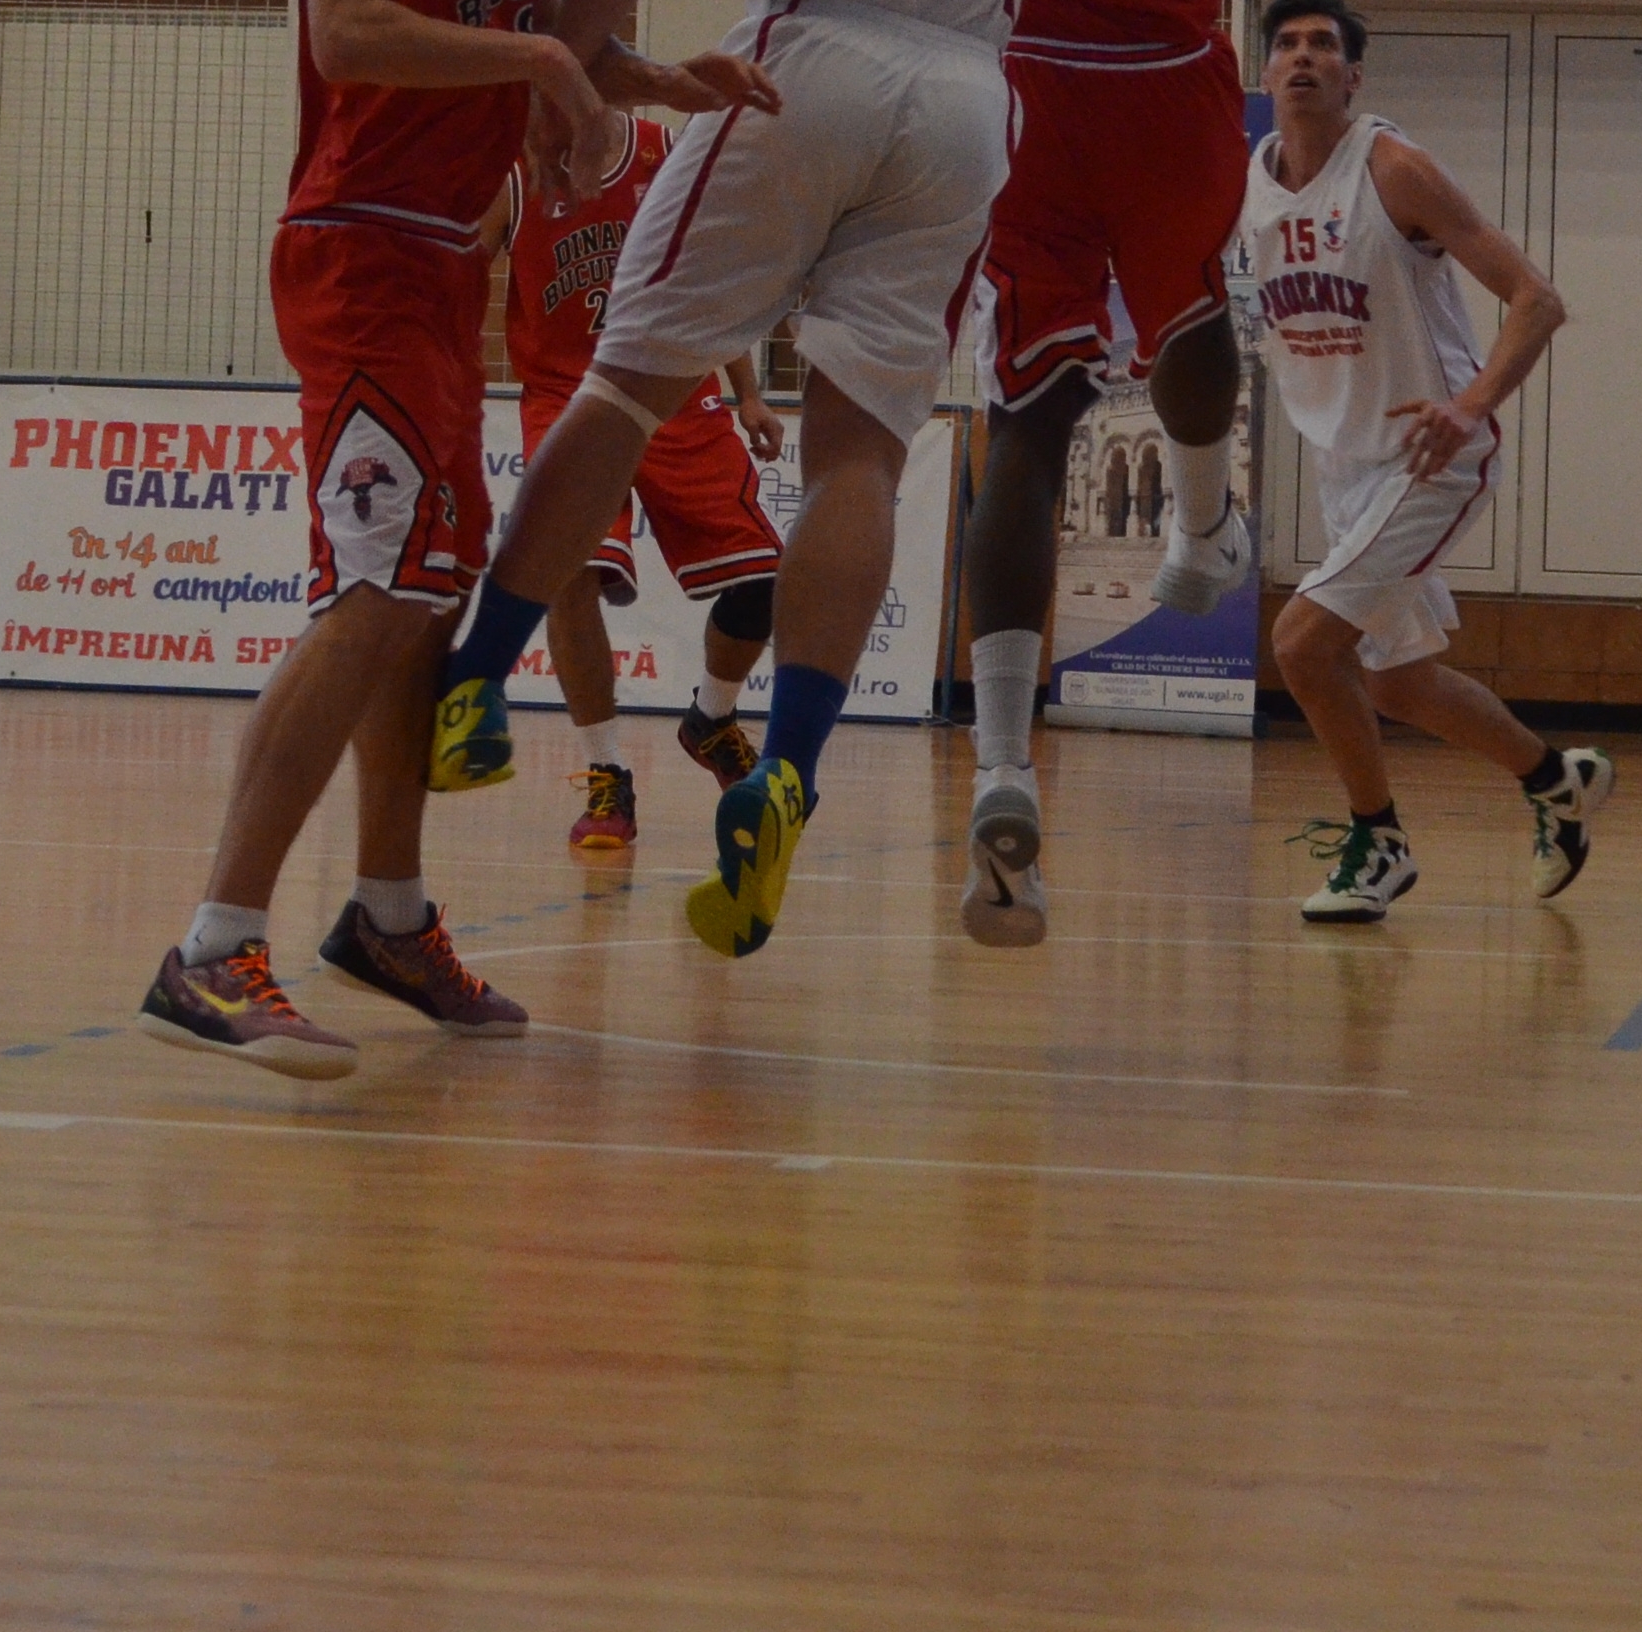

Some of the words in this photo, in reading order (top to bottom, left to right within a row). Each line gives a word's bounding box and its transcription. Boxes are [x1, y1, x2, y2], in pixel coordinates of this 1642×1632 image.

[1279, 218, 1316, 263] 15
[10, 418, 303, 476] PHOENIX
[105, 468, 291, 516] GALAȚI
[68, 526, 110, 560] în
[115, 531, 157, 568] 14
[165, 535, 220, 564] ani
[16, 560, 51, 592] de
[56, 569, 86, 595] 11
[91, 572, 137, 598] ori
[153, 572, 303, 613] campioni
[1, 619, 215, 663] ÎMPREUNĂ
[1177, 688, 1245, 703] www.ugal.ro
